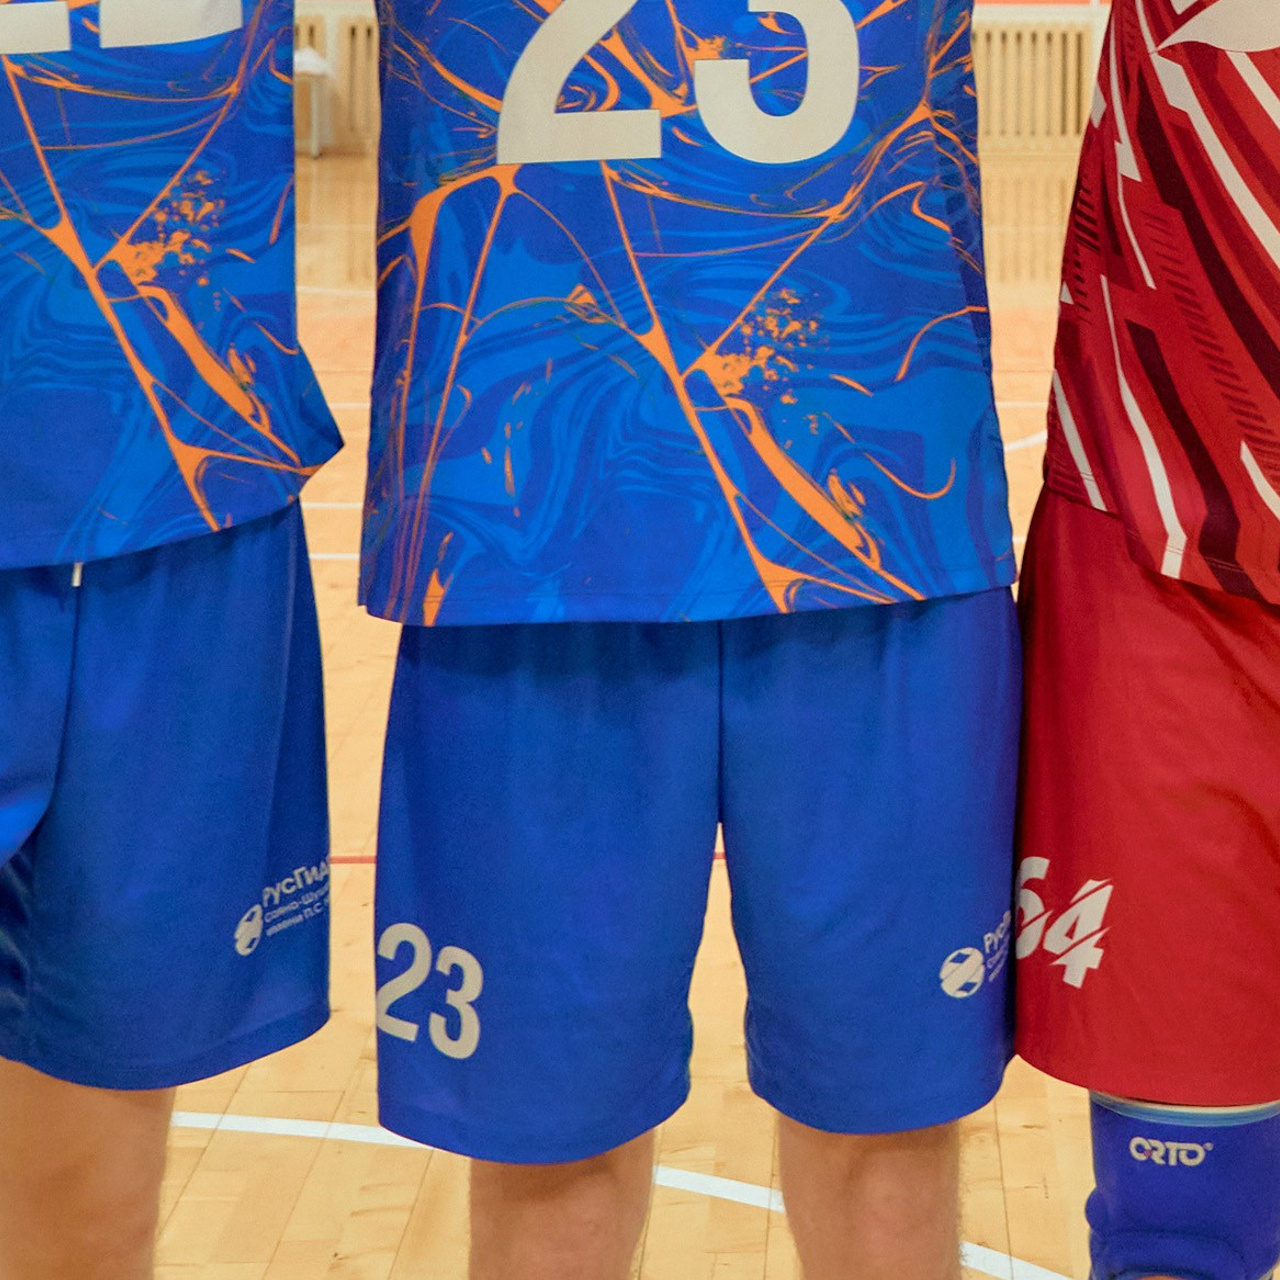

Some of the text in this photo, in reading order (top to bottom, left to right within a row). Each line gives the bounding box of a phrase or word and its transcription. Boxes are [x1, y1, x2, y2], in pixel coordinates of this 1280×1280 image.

[1014, 856, 1114, 989] 64
[376, 922, 485, 1061] 23
[1129, 1136, 1206, 1166] ORTO
